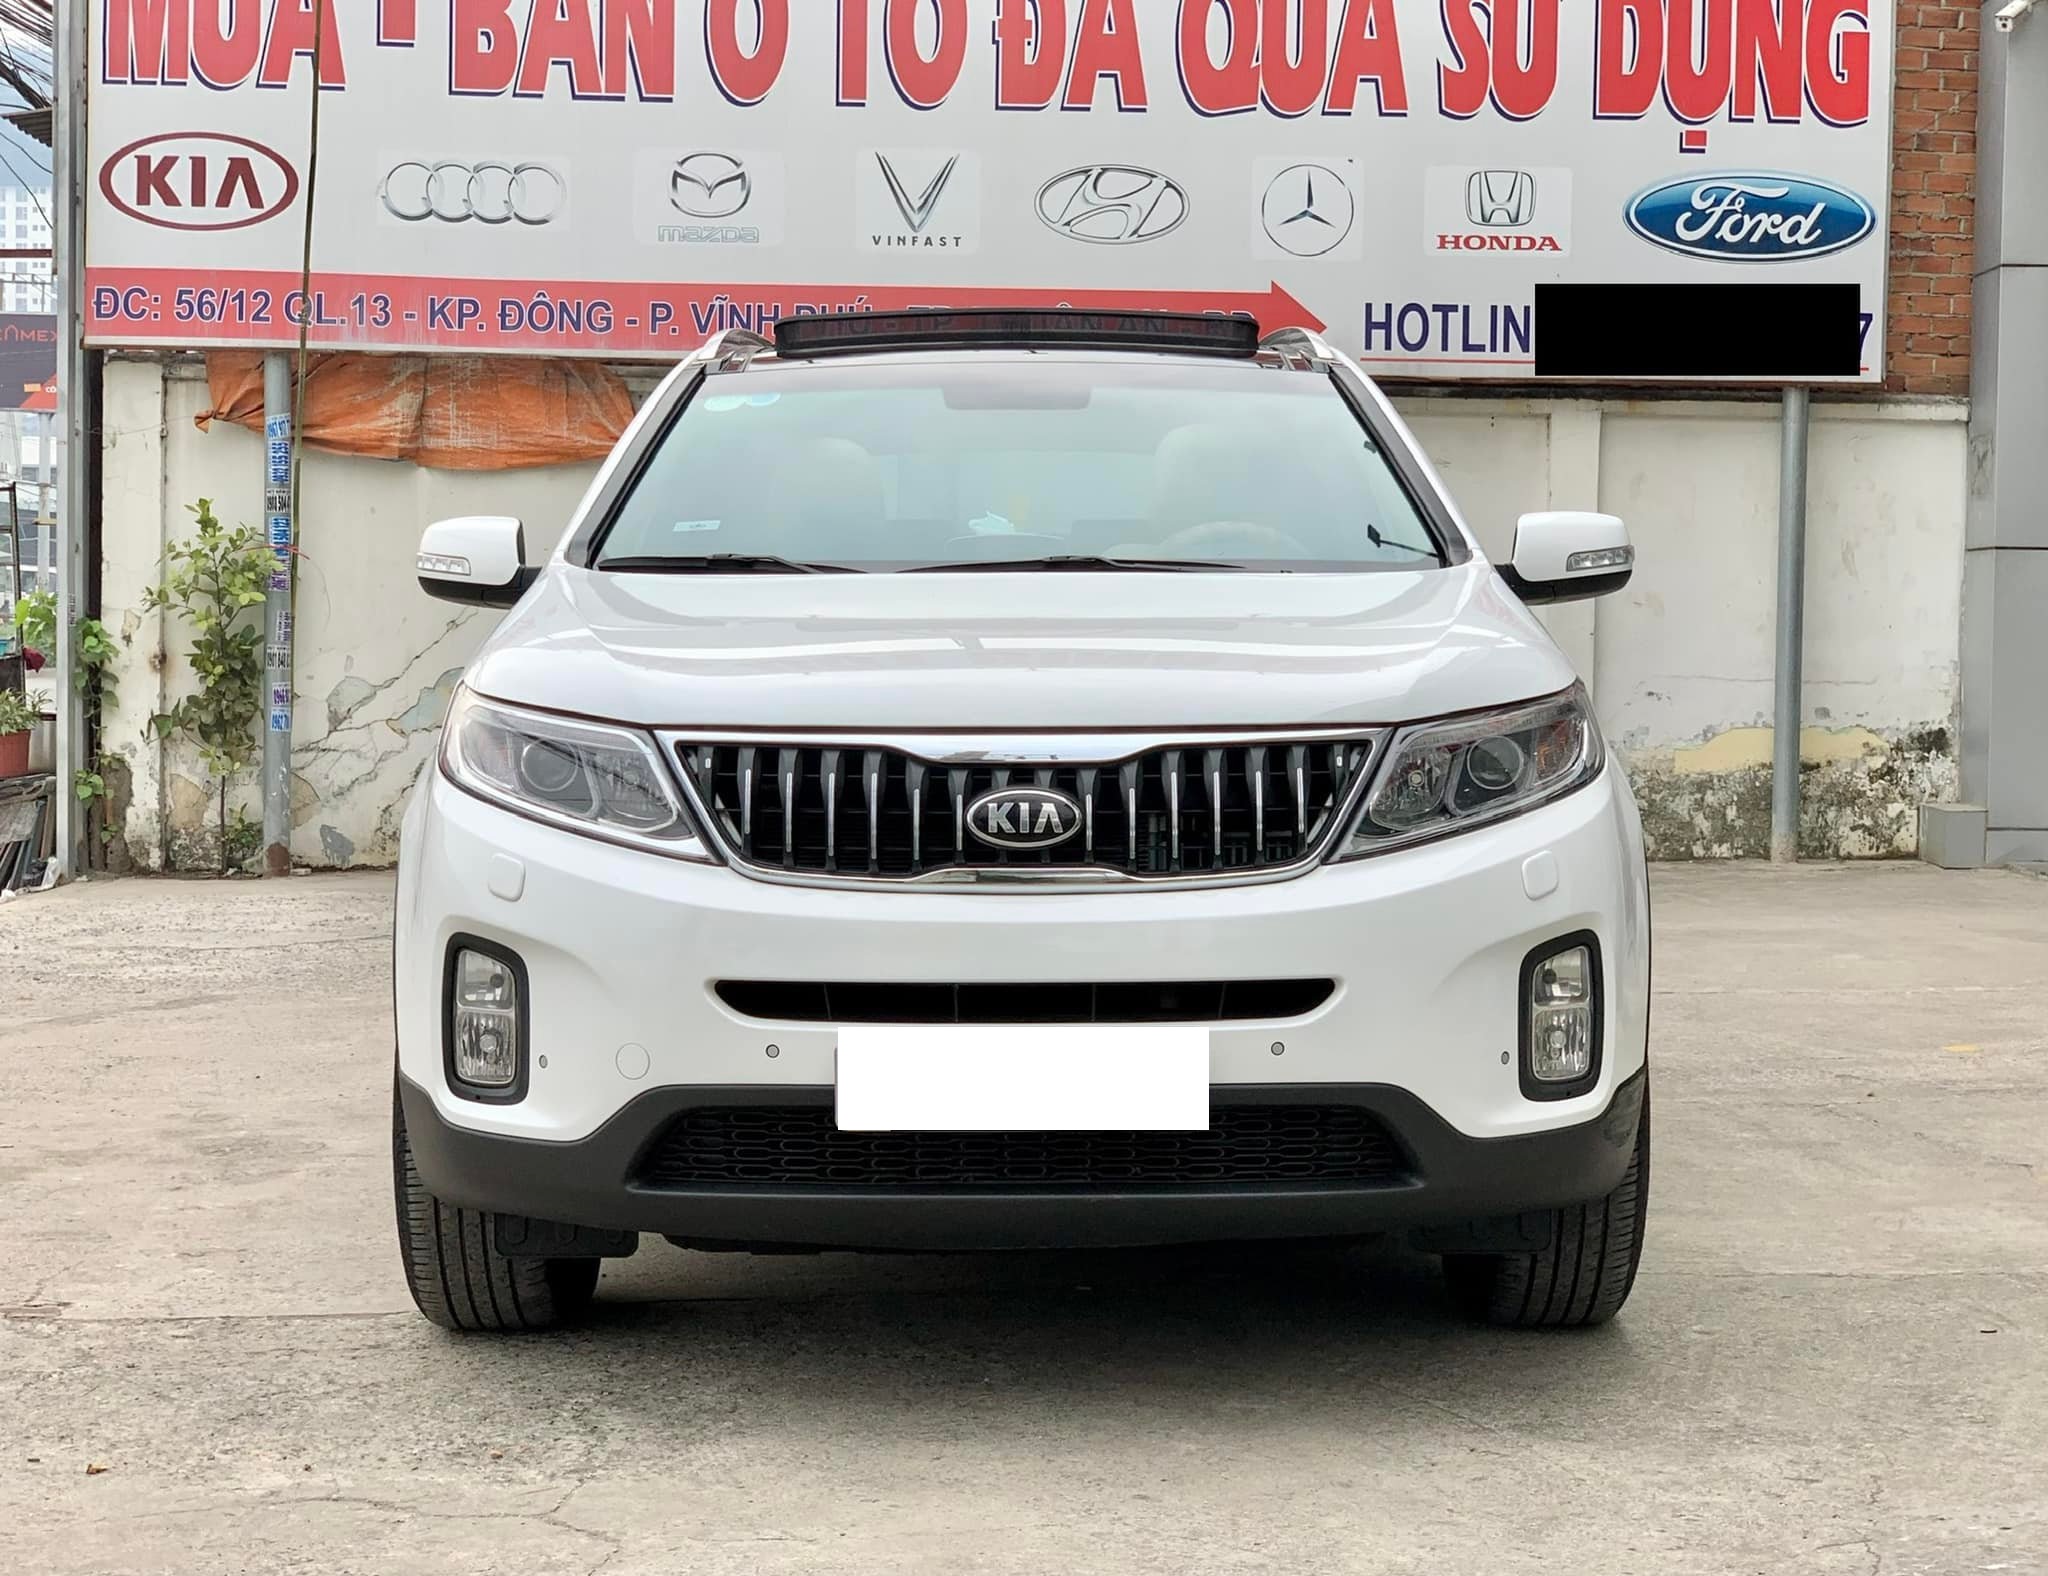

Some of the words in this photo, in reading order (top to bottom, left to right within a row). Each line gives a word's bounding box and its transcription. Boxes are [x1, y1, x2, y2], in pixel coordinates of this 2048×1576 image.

[134, 155, 265, 209] KIA
[1675, 179, 1826, 246] Ford
[872, 235, 962, 248] VINFAST
[1436, 234, 1563, 252] HONDA
[93, 286, 162, 321] ĐC:
[173, 288, 273, 323] 56/12
[428, 296, 486, 331] KP.
[497, 291, 613, 334] ĐÔNG
[649, 301, 679, 334] P.
[1363, 302, 1531, 354] HOTLIN
[987, 802, 1063, 833] KIA
